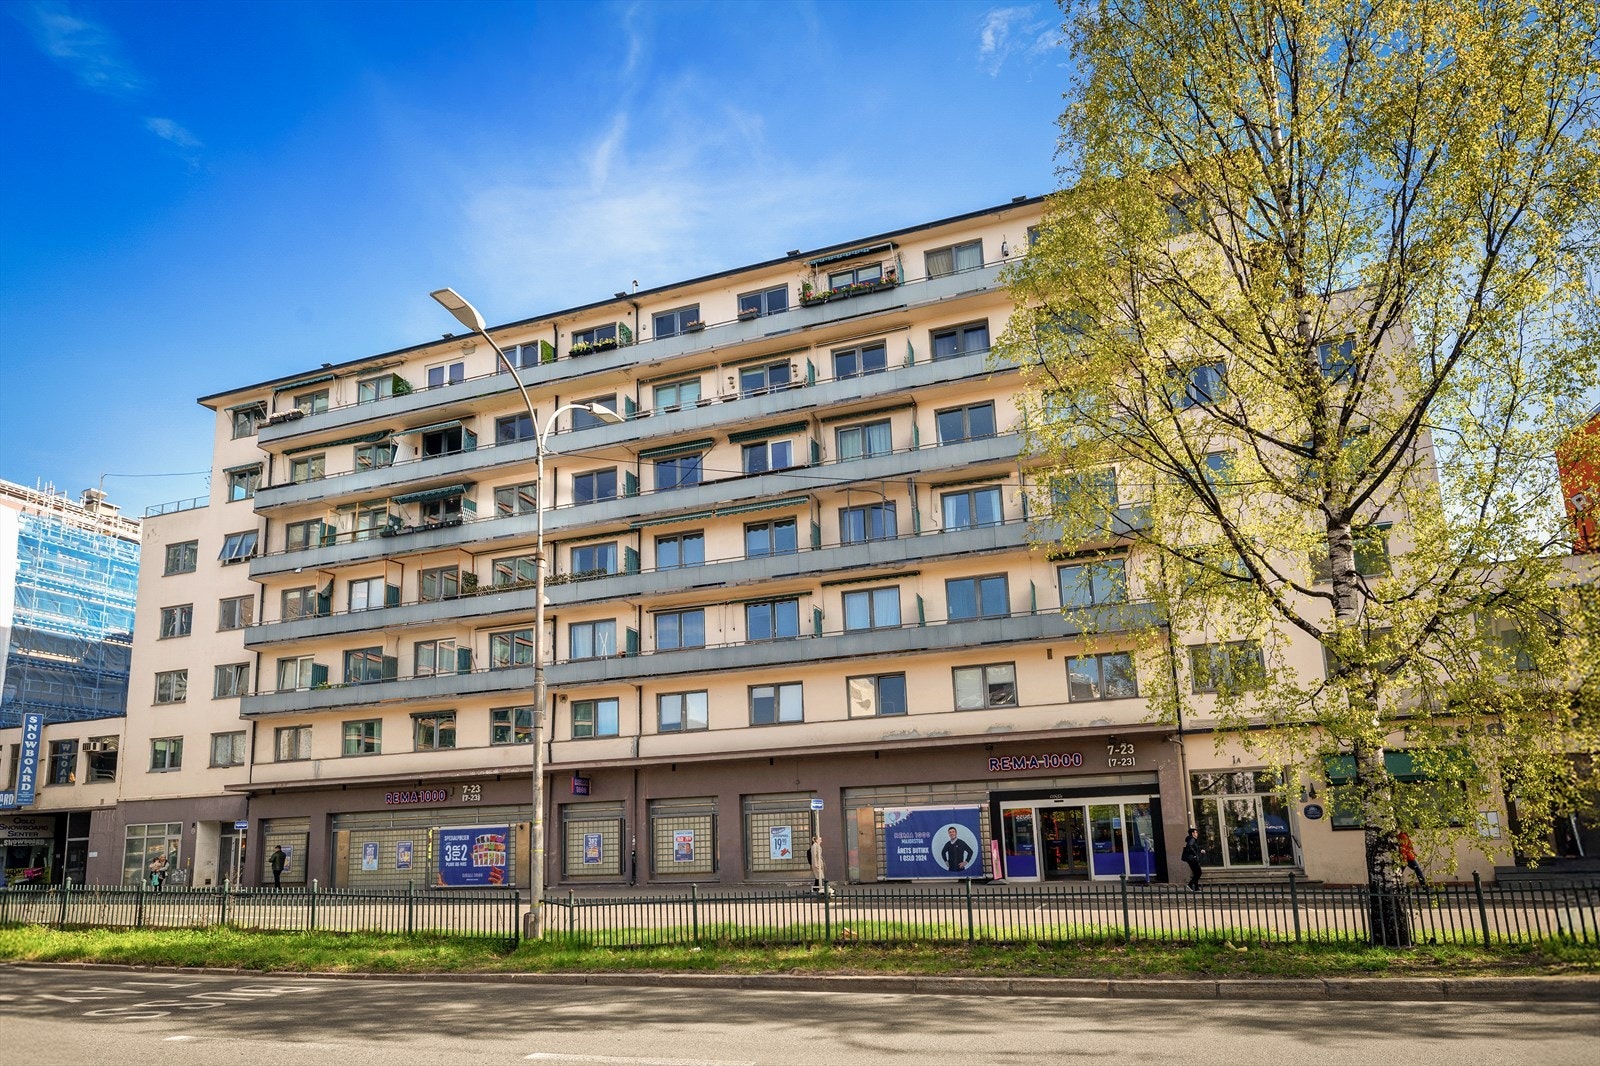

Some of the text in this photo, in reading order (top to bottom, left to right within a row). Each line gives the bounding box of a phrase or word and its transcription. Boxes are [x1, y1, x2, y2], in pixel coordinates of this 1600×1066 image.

[21, 716, 38, 791] SNOWBOARD
[1107, 744, 1135, 755] 7-23
[988, 753, 1083, 771] REMA 1000
[1108, 757, 1136, 767] (7-23)
[462, 785, 480, 793] 7-23
[385, 790, 446, 804] REMA 1000
[462, 794, 480, 802] (7-23)
[445, 844, 468, 862] 3 FOR 2
